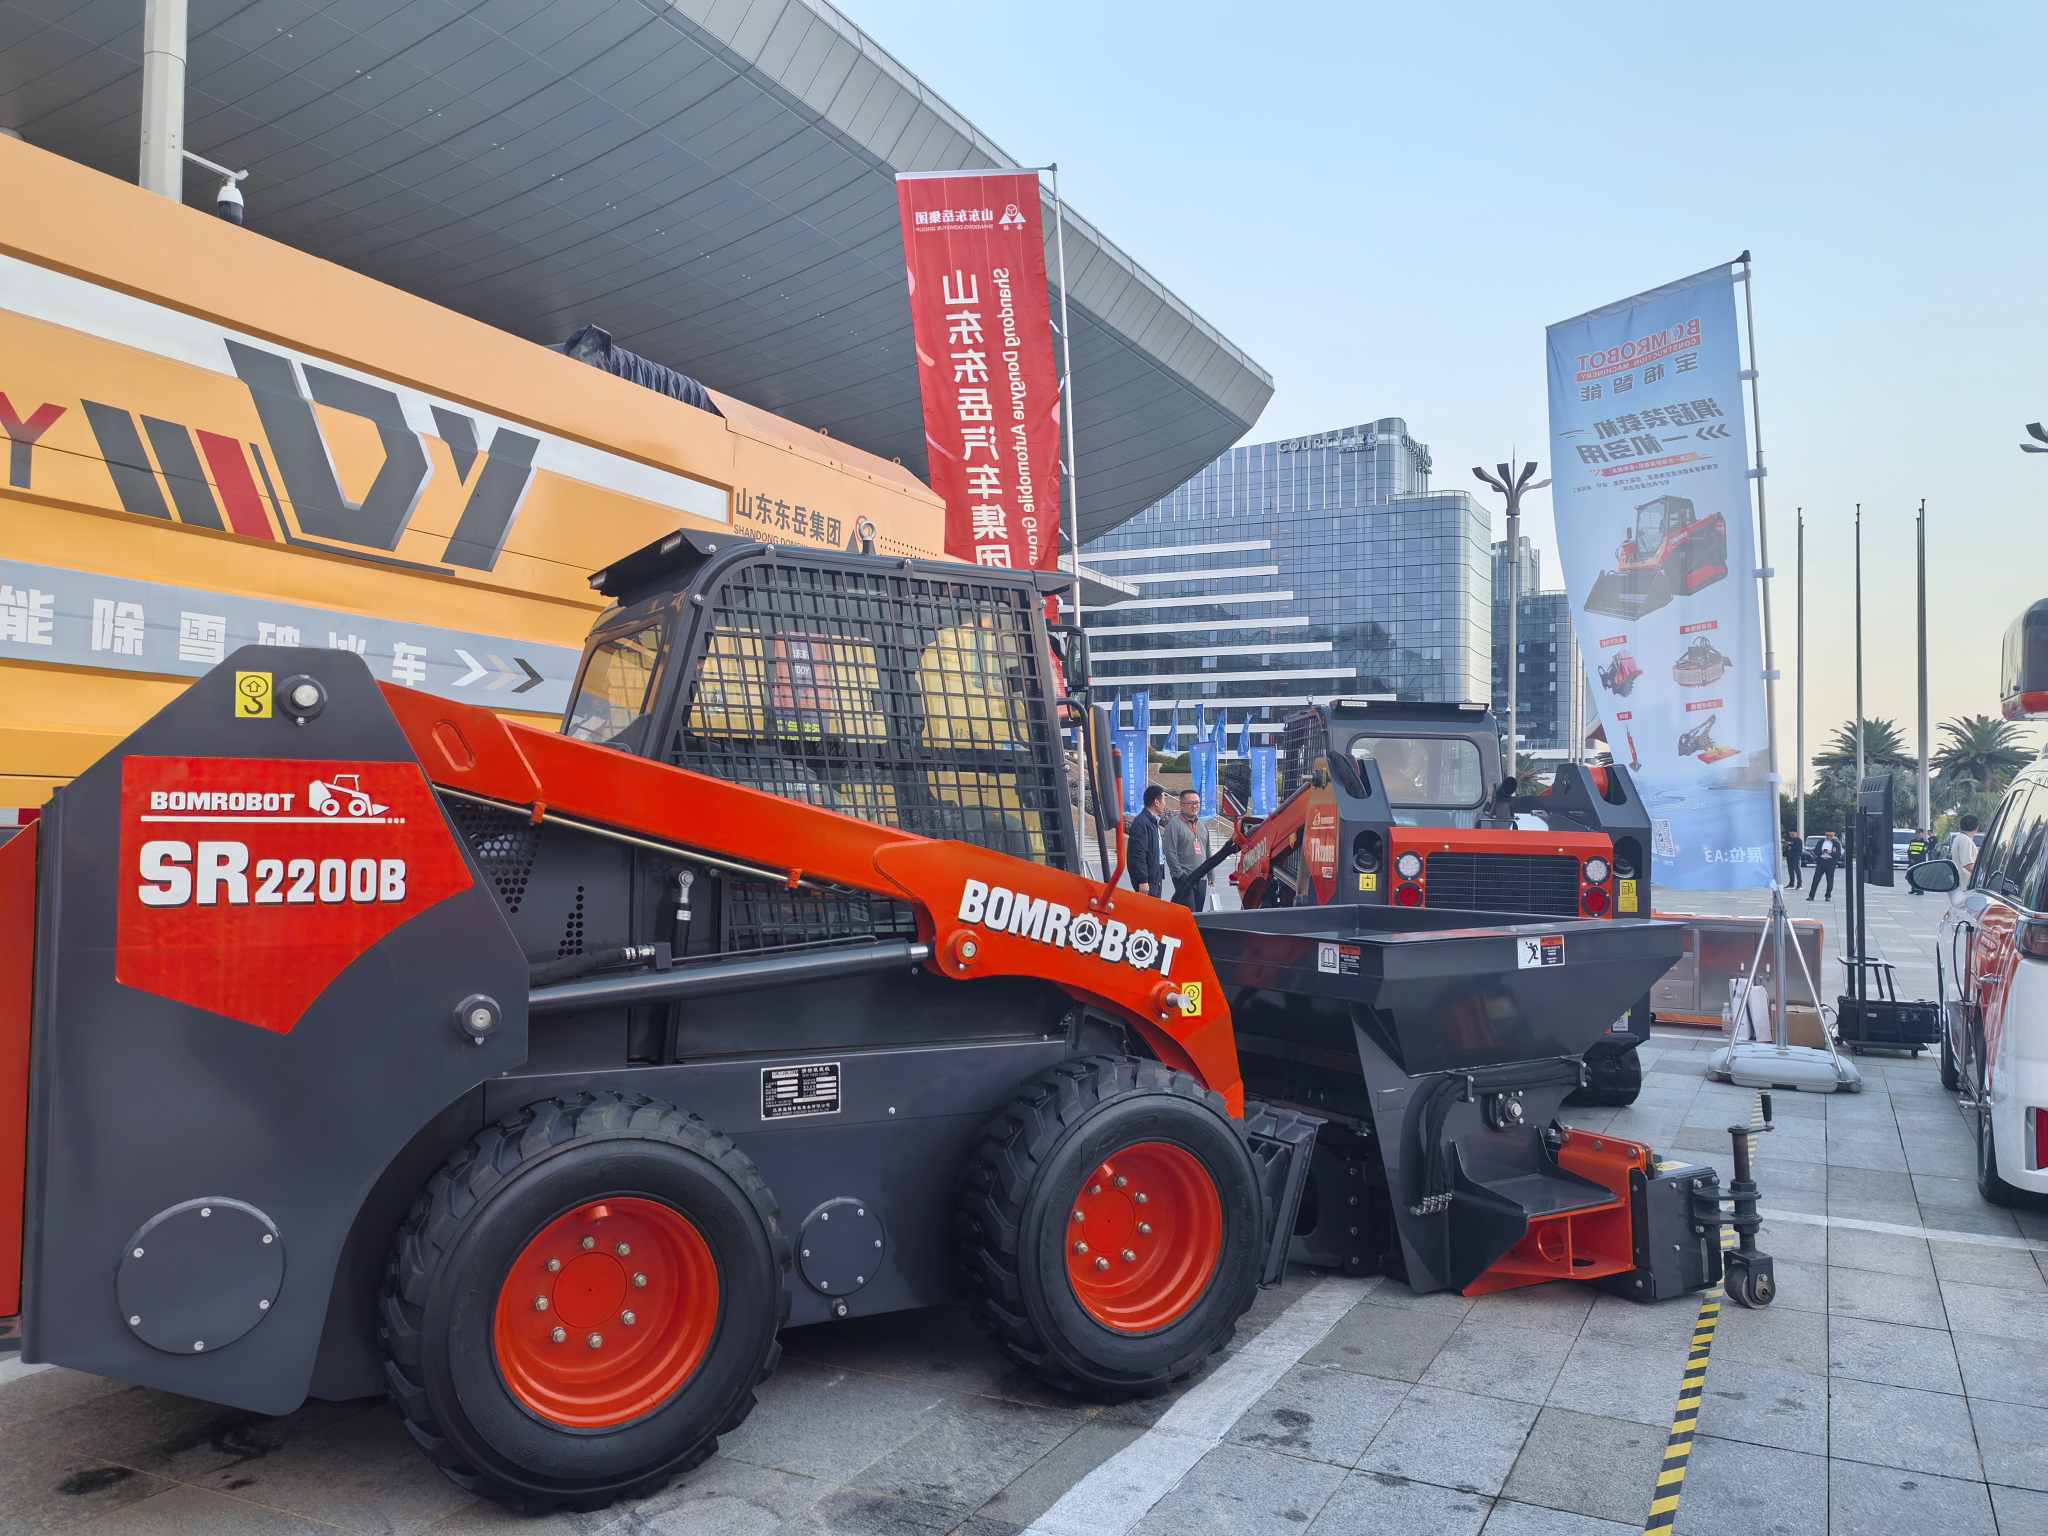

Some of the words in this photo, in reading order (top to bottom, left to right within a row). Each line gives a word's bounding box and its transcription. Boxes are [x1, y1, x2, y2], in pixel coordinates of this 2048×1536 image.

[736, 487, 841, 547] 山东东岳集团
[150, 791, 296, 812] BOMROBOT
[958, 879, 1182, 976] BOMROBOT
